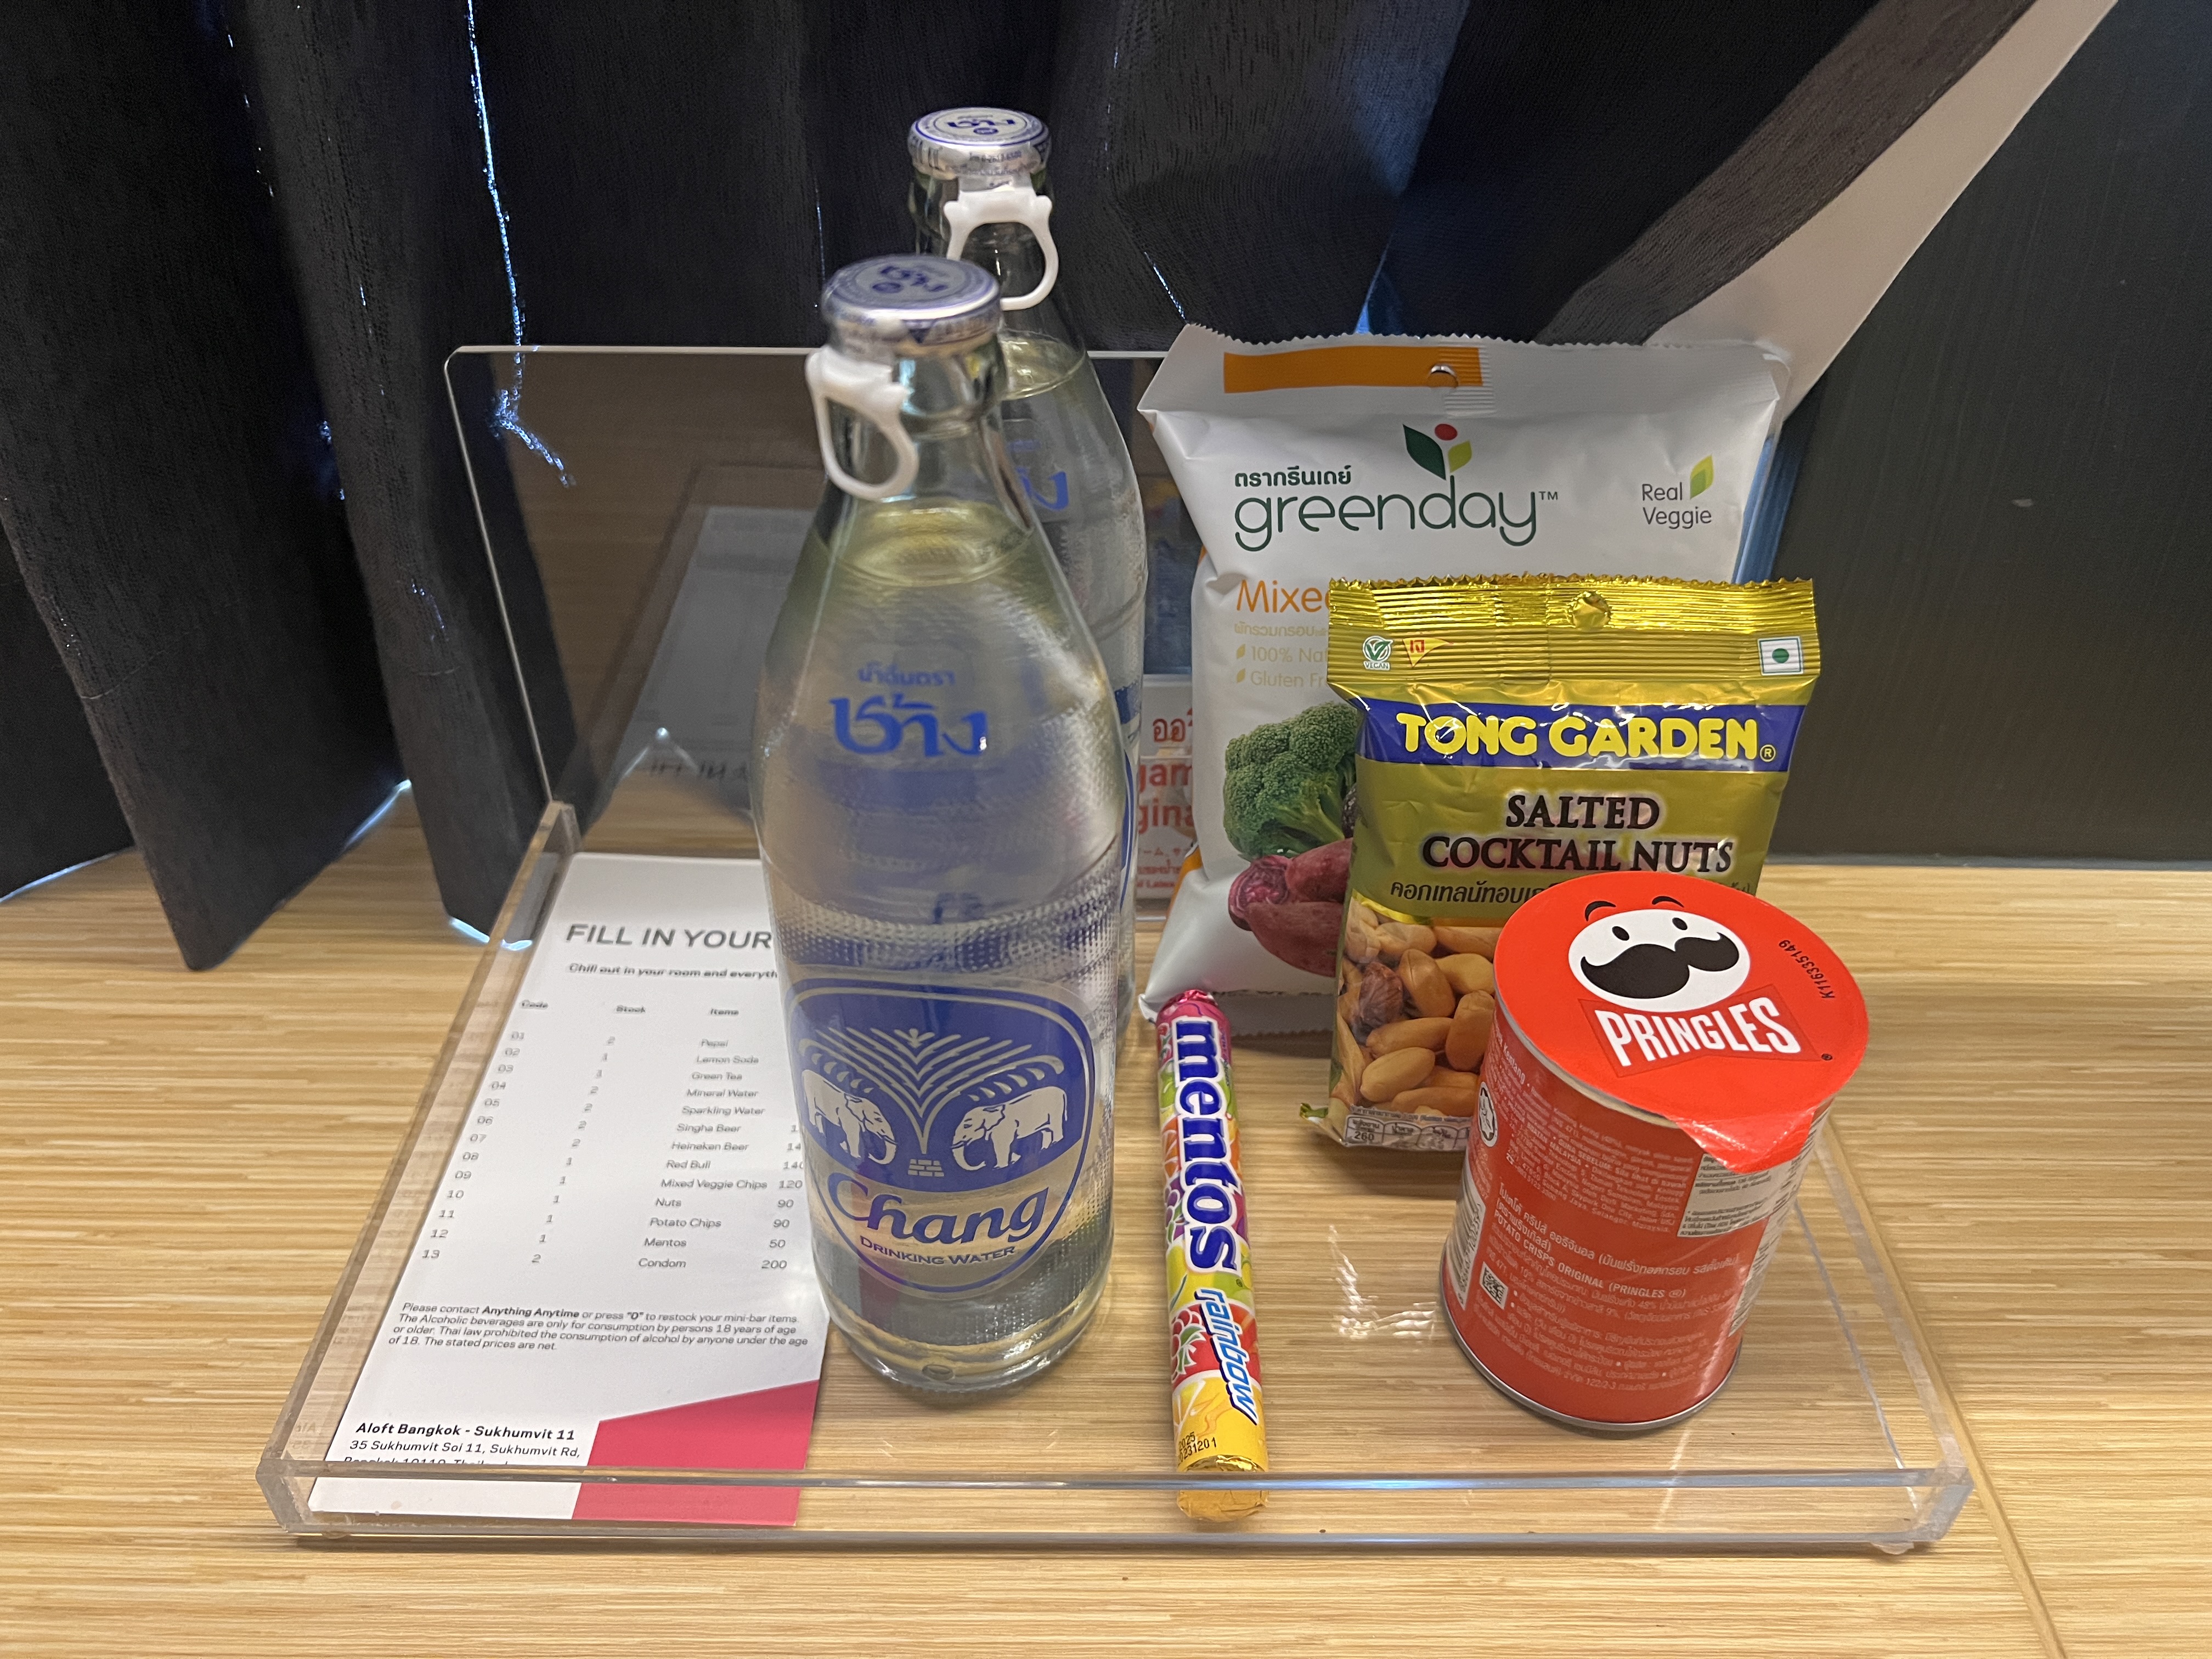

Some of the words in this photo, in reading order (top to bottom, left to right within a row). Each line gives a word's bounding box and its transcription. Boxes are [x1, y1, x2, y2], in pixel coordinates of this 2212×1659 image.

[1234, 465, 1352, 487] ตรากรีนเดย์
[1642, 482, 1683, 501] Real
[1234, 475, 1536, 552] greenday
[1643, 506, 1712, 529] Veggie
[1236, 579, 1329, 613] Mixe
[1251, 646, 1293, 663] 100%
[1250, 670, 1304, 688] Gluten
[1310, 673, 1324, 688] Fr
[828, 692, 988, 758] ช้าง
[1396, 712, 1539, 757] TONG
[1548, 714, 1758, 760] GARDEN
[1506, 793, 1660, 830] SALTED
[1423, 837, 1622, 873] COCKTAIL
[1632, 839, 1734, 873] NUTS
[566, 923, 633, 946] FILL
[642, 927, 676, 947] IN
[684, 928, 773, 949] YOUR
[569, 963, 598, 974] Chill
[600, 966, 620, 975] out
[624, 966, 635, 975] in
[638, 968, 664, 978] your
[668, 969, 701, 977] room
[703, 968, 727, 978] and
[729, 969, 777, 980] everyth
[1779, 940, 1835, 998] K116335149
[710, 1007, 739, 1015] Items
[1594, 996, 1802, 1067] PRINGLES
[504, 1047, 520, 1057] 02
[696, 1055, 730, 1064] Lemon
[732, 1055, 759, 1064] Soda
[498, 1064, 514, 1073] 03
[692, 1071, 723, 1080] Green
[726, 1071, 742, 1080] Tea
[491, 1081, 506, 1090] 04
[687, 1088, 725, 1097] Mineral
[727, 1088, 759, 1098] Water
[484, 1098, 500, 1107] 05
[584, 1103, 593, 1112] 2
[682, 1105, 731, 1116] Sparkling
[735, 1106, 765, 1115] Water
[477, 1115, 493, 1125] 06
[578, 1120, 586, 1130] 2
[677, 1123, 713, 1133] Singha
[716, 1124, 741, 1133] Beer
[470, 1133, 487, 1143] 07
[572, 1138, 580, 1147] 2
[672, 1141, 721, 1151] Heineken
[724, 1141, 749, 1151] Beer
[1176, 1020, 1238, 1271] mentos
[1354, 1131, 1374, 1141] 260
[462, 1152, 479, 1161] 08
[666, 1159, 688, 1169] Red
[690, 1160, 711, 1169] Bull
[455, 1170, 472, 1180] 09
[661, 1178, 694, 1188] Mixed
[697, 1179, 733, 1189] Veggie
[736, 1179, 768, 1190] Chips
[778, 1180, 803, 1189] 120
[447, 1189, 464, 1199] 10
[655, 1197, 681, 1207] Nuts
[777, 1199, 794, 1208] 90
[827, 1172, 1049, 1244] Chang
[439, 1209, 454, 1218] 11
[650, 1217, 687, 1227] Potato
[690, 1217, 721, 1229] Chips
[773, 1219, 790, 1228] 90
[430, 1229, 449, 1238] 12
[538, 1234, 546, 1243] 1
[644, 1237, 687, 1248] Mentos
[769, 1239, 786, 1248] 50
[421, 1249, 440, 1259] 13
[531, 1254, 541, 1263] 2
[638, 1257, 686, 1268] Condom
[761, 1260, 787, 1269] 200
[860, 1235, 945, 1265] DRINKING
[948, 1246, 1016, 1265] WATER
[1494, 1209, 1521, 1243] POTATO
[1523, 1239, 1556, 1267] CRISPS
[1558, 1262, 1605, 1289] ORIGINAL
[402, 1302, 437, 1312] Please
[440, 1305, 479, 1314] contact
[482, 1306, 532, 1317] Anything
[534, 1308, 579, 1318] Anytime
[582, 1311, 592, 1319] or
[595, 1312, 624, 1321] press
[658, 1313, 697, 1322] restock
[699, 1314, 722, 1323] your
[724, 1313, 767, 1323] mini-bar
[399, 1313, 417, 1322] The
[420, 1314, 468, 1324] Alcoholic
[470, 1316, 524, 1328] beverages
[546, 1320, 568, 1330] only
[571, 1321, 585, 1329] for
[588, 1321, 654, 1333] consumption
[657, 1323, 670, 1333] by
[672, 1324, 713, 1334] persons
[716, 1324, 731, 1333] 18
[733, 1325, 761, 1335] years
[764, 1325, 776, 1334] of
[777, 1326, 797, 1336] age
[388, 1335, 402, 1344] of
[425, 1336, 443, 1346] The
[445, 1338, 482, 1347] stated
[482, 1339, 516, 1350] prices
[439, 1325, 461, 1335] Thai
[464, 1327, 482, 1335] law
[483, 1328, 538, 1339] prohibited
[540, 1330, 557, 1339] the
[560, 1332, 627, 1343] consumption
[629, 1333, 641, 1342] of
[642, 1333, 680, 1343] alcohol
[682, 1335, 695, 1345] by
[697, 1336, 734, 1345] anyone
[737, 1336, 767, 1345] under
[769, 1336, 786, 1345] the
[788, 1338, 808, 1347] age
[1200, 1288, 1259, 1422] rainbow
[356, 1422, 394, 1434] Aloft
[397, 1424, 462, 1437] Bangkok
[474, 1425, 553, 1440] Sukhumvit
[556, 1430, 574, 1440] 11
[349, 1440, 368, 1449] 35
[370, 1441, 439, 1452] Sukhumvit
[442, 1442, 463, 1452] Soi
[465, 1443, 486, 1454] 11,
[490, 1444, 557, 1457] Sukhumvit
[561, 1447, 580, 1458] Rd,
